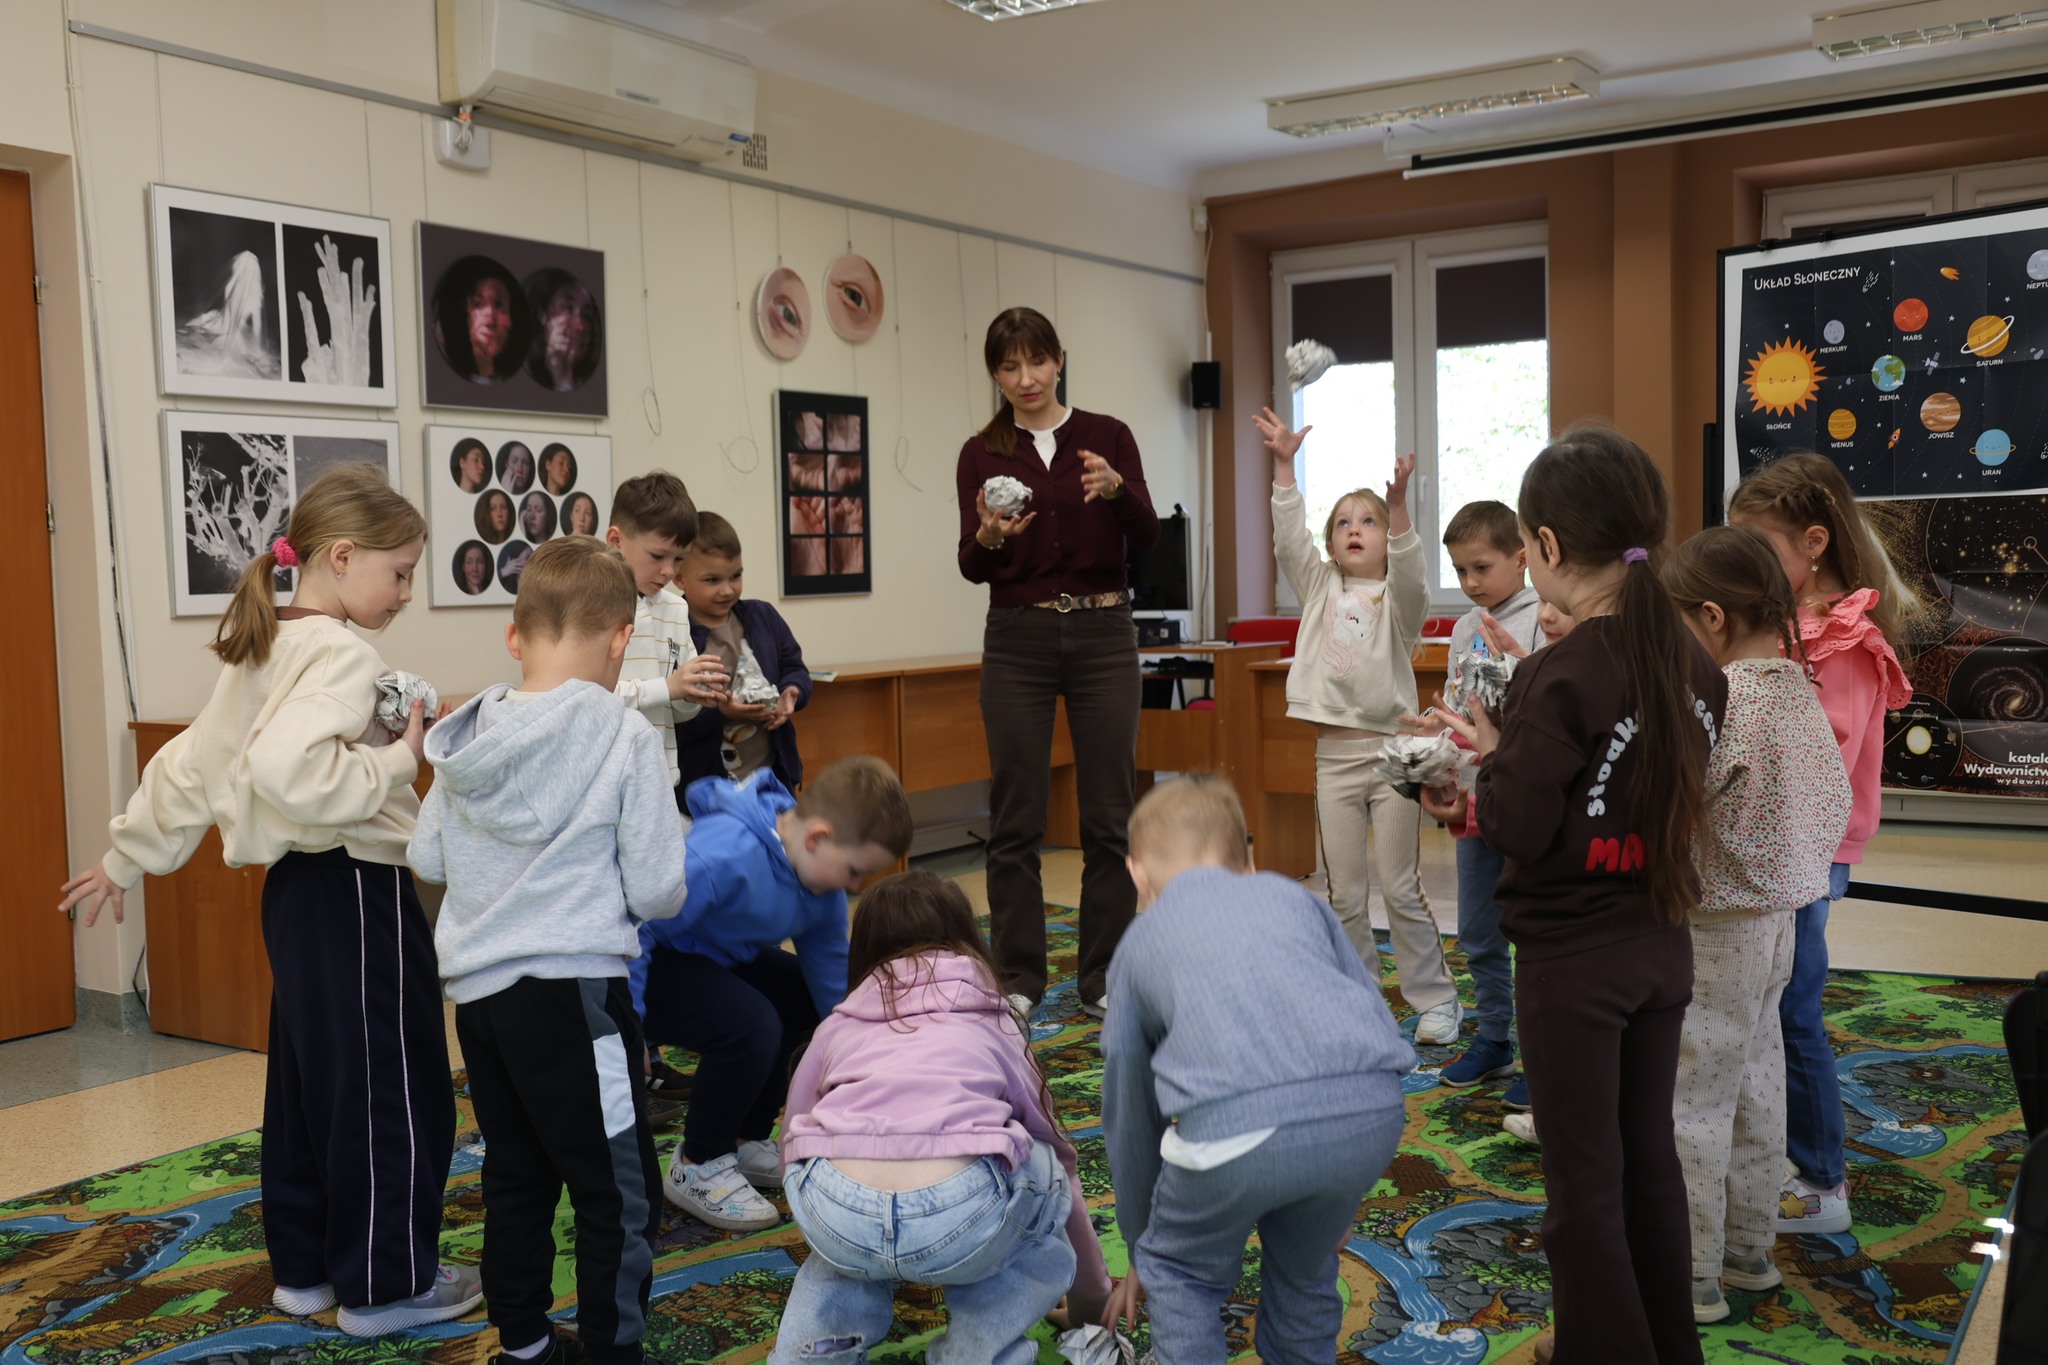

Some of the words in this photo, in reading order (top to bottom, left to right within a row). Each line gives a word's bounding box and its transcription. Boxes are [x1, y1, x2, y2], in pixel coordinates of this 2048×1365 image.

[1754, 276, 1791, 291] UKŁAD
[1794, 266, 1861, 285] SŁONECZNY
[1903, 334, 1923, 342] MARS
[1819, 345, 1848, 354] MERKURY
[1976, 358, 2004, 367] SATURN
[1878, 394, 1900, 402] ZIEMIA
[1928, 431, 1955, 440] JOWISZ
[1585, 833, 1645, 872] MA
